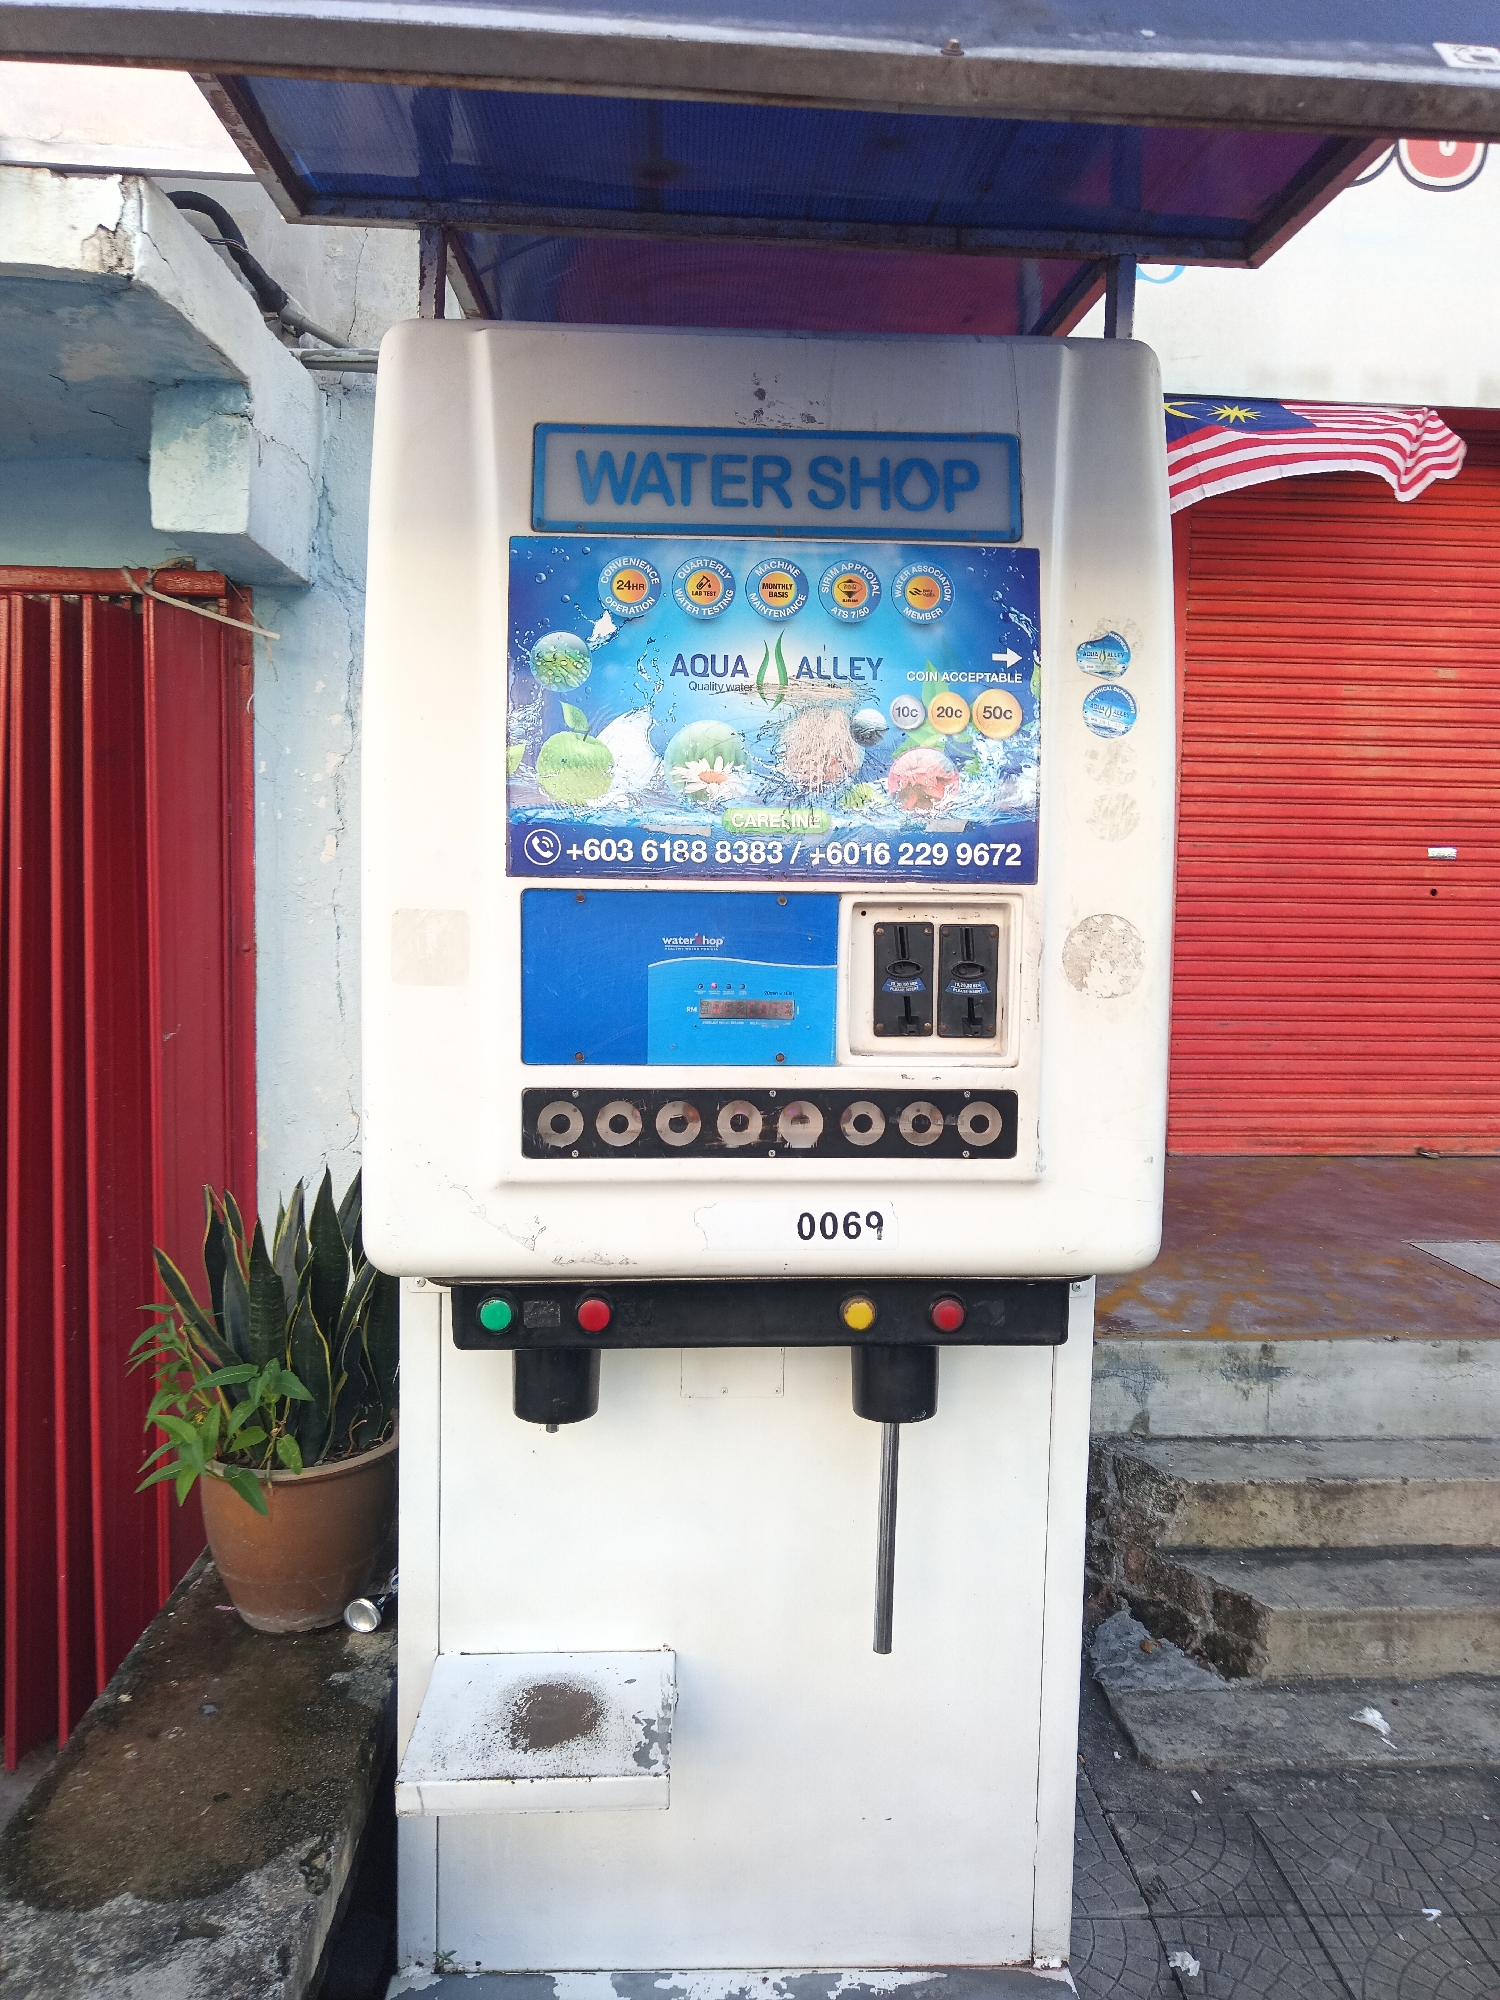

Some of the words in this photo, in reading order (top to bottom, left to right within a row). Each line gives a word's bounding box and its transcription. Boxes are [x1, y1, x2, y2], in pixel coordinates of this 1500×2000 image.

[576, 450, 792, 509] WATER
[807, 455, 980, 513] SHOP
[601, 557, 661, 585] CONVENIENCE
[677, 559, 732, 580] QUARTERLY
[755, 561, 801, 578] MACHINE
[616, 579, 645, 591] 24HR
[762, 583, 793, 591] MONTHLY
[821, 567, 840, 593] SIRIM
[841, 563, 881, 597] APPROVAL
[895, 570, 911, 598] WATER
[911, 565, 951, 602] ASSOCIATION
[605, 596, 655, 615] OPERATION
[674, 588, 700, 616] WATER
[701, 589, 734, 616] TESTING
[749, 592, 806, 618] MAINTENANCE
[831, 607, 849, 618] ATS
[851, 607, 870, 619] 7/50
[903, 607, 944, 621] MEMBER
[670, 654, 749, 677] AQUA
[796, 656, 884, 681] ALLEY
[688, 681, 723, 693] Quality
[725, 683, 753, 692] water
[906, 671, 938, 682] COIN
[941, 671, 1023, 684] ACCEPTABLE
[1088, 686, 1113, 702] TECHNICAL
[1113, 686, 1135, 714] DEPARTMENT
[895, 706, 919, 718] 10c
[936, 706, 963, 719] 20c
[983, 705, 1013, 720] 50c
[732, 813, 820, 828] CARELINE
[566, 839, 633, 862] +603
[641, 840, 708, 863] 6188
[714, 841, 783, 864] 8383
[789, 842, 801, 864] /
[809, 842, 891, 865] +6016
[898, 843, 948, 866] 229
[956, 843, 1022, 866] 9672
[797, 1211, 884, 1241] 0069
